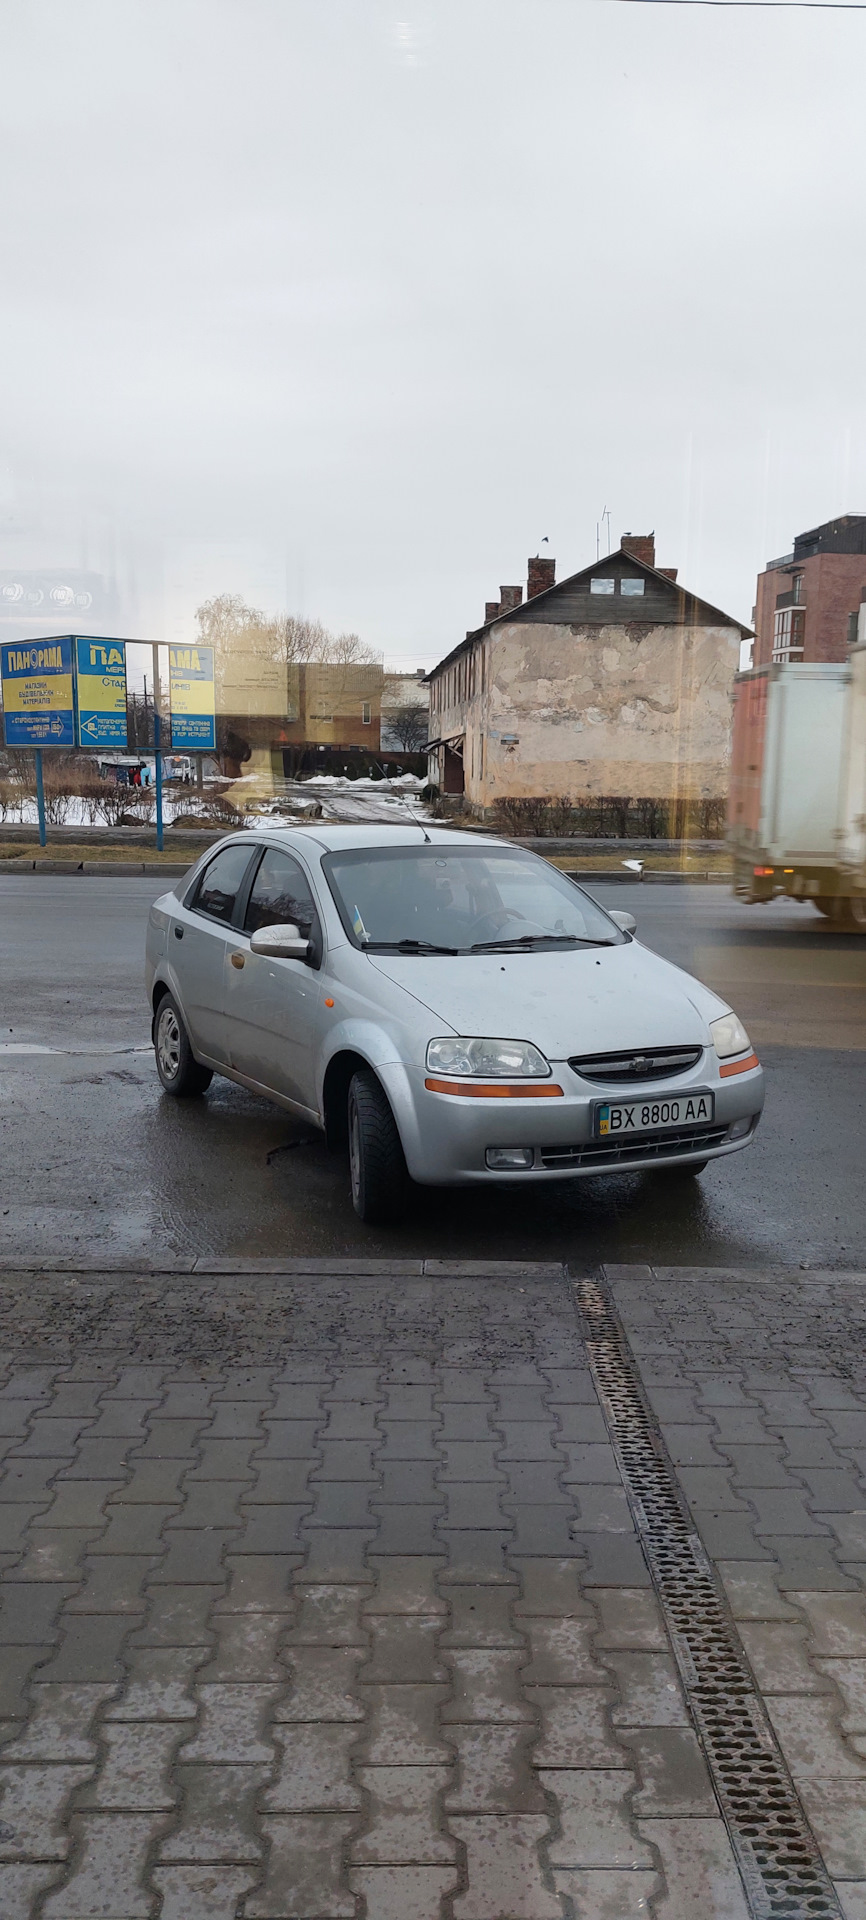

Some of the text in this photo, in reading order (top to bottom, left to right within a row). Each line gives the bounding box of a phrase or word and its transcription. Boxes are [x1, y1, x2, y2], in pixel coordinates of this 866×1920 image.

[8, 646, 62, 672] ПАНОРАМА
[89, 644, 126, 666] ПА
[610, 1098, 708, 1130] BX 8800 AA
